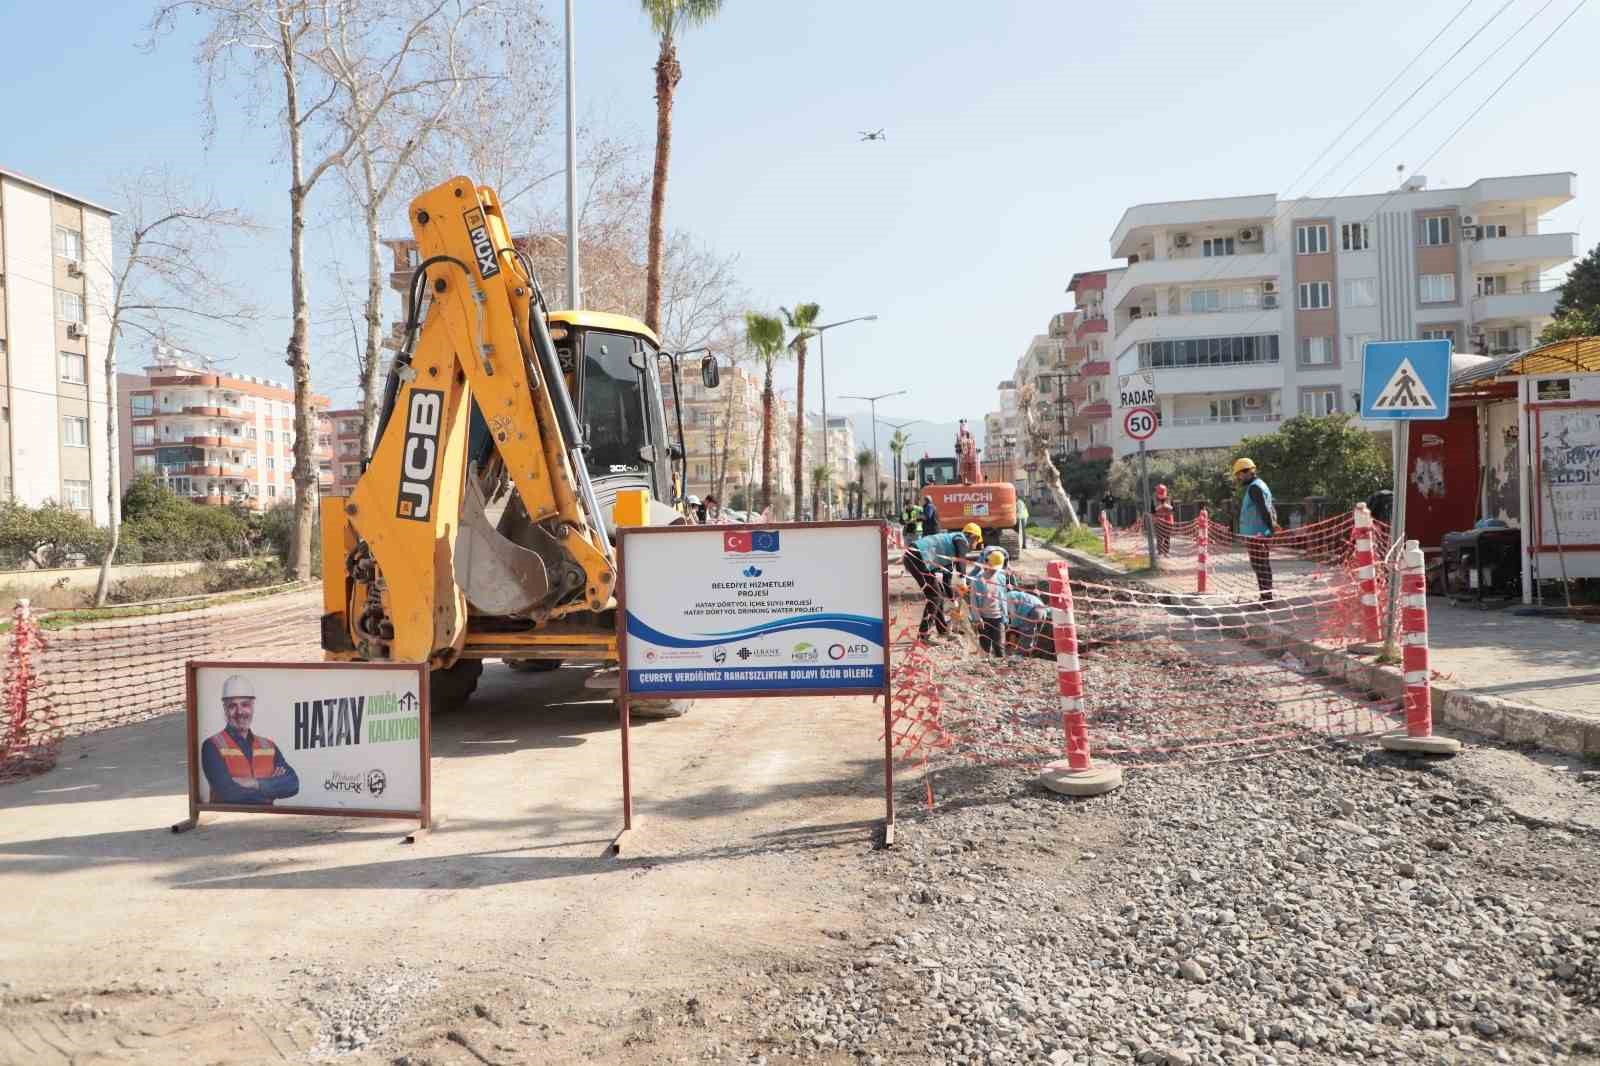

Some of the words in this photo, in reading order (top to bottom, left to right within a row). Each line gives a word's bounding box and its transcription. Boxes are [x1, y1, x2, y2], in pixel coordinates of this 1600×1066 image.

[471, 227, 497, 272] 3CX
[1121, 389, 1154, 406] RADAR
[1131, 416, 1152, 432] 50
[402, 393, 440, 518] JCB
[944, 491, 992, 503] HITACHI
[711, 581, 747, 589] BELEDİYE
[750, 580, 794, 588] HİZMETLERİ
[738, 589, 769, 597] PROJESİ
[684, 608, 704, 616] HATAY
[771, 606, 793, 614] WATER
[795, 605, 824, 613] PROJECT
[847, 645, 869, 653] AFD
[675, 669, 722, 682] VERDİĞİMİZ
[844, 667, 873, 678] DİLERİZ
[368, 690, 399, 716] AYAĞA
[294, 696, 365, 751] HATAY
[368, 717, 418, 744] KALKIYOR
